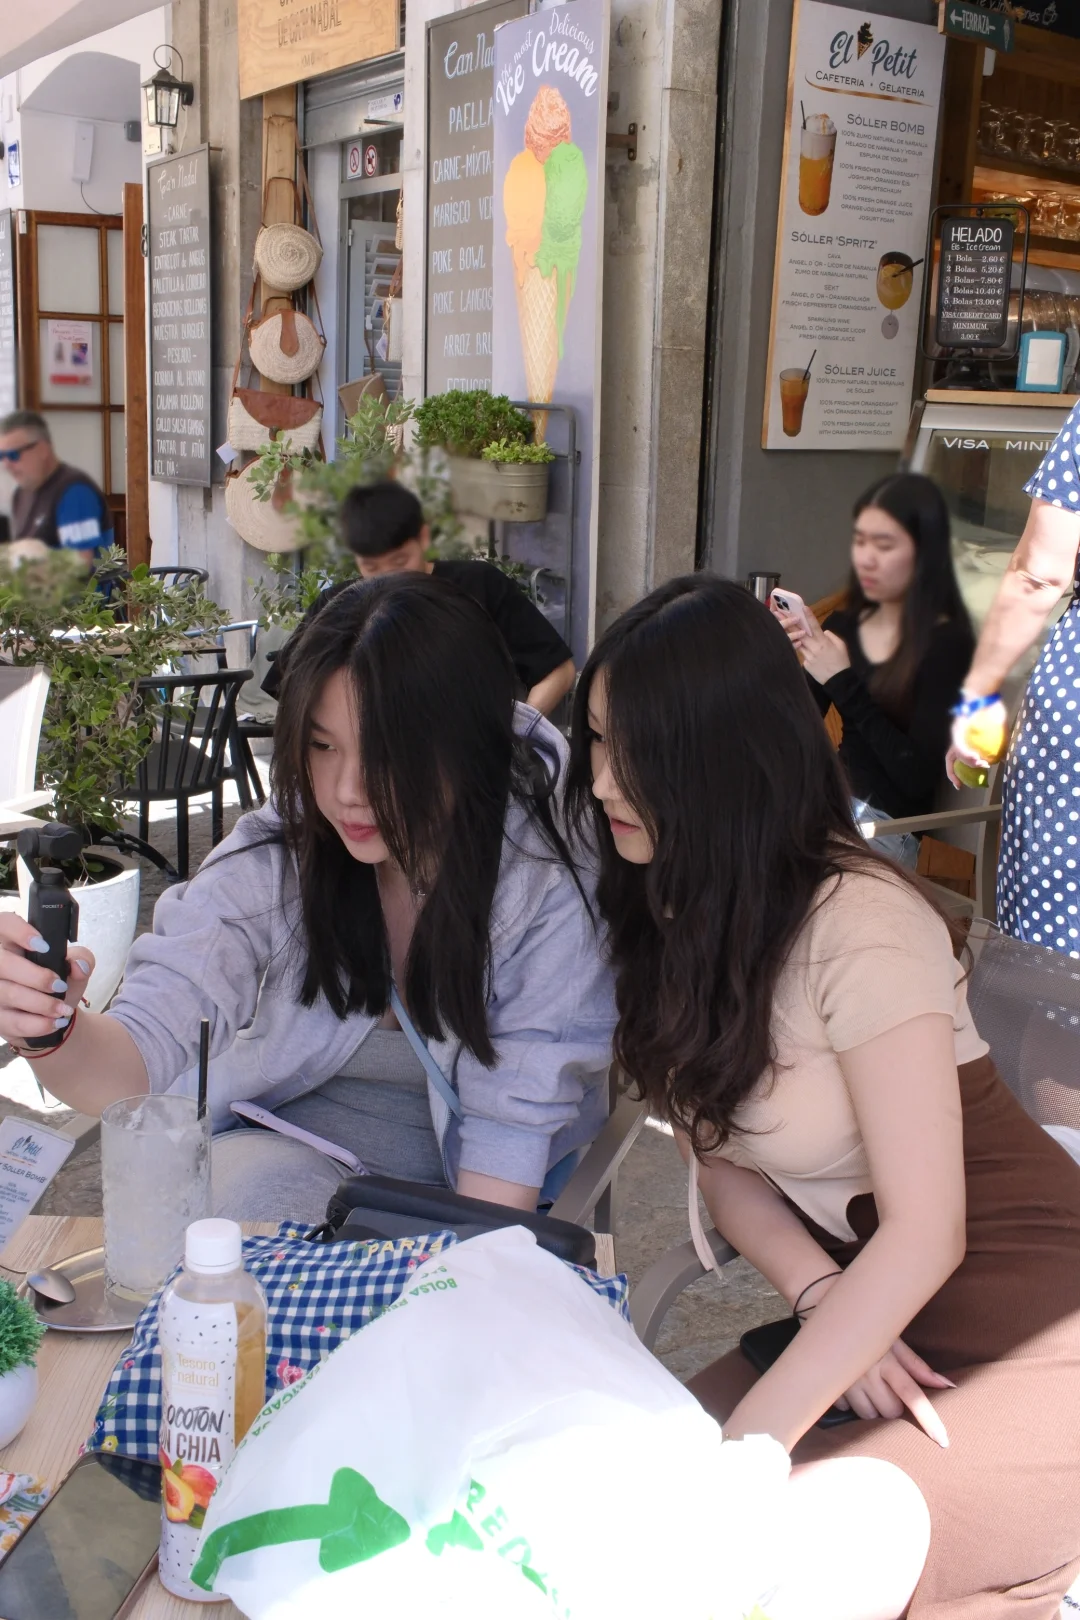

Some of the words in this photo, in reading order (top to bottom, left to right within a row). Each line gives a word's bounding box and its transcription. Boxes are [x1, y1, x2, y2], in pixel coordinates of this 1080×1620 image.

[962, 9, 990, 35] TERRAZA
[501, 63, 512, 86] the
[514, 29, 533, 63] most
[549, 8, 595, 54] Delicious
[829, 31, 854, 69] El
[871, 40, 918, 79] Petit
[444, 41, 473, 79] Can
[495, 64, 525, 117] Ice
[532, 31, 598, 97] Cream
[815, 70, 865, 88] CAFETERIA
[878, 81, 925, 99] GELATERIA
[449, 97, 494, 134] PAELLA
[856, 132, 873, 140] ZUMO
[890, 120, 925, 136] BOMB
[845, 140, 867, 149] HELADO
[859, 151, 881, 160] ESPUMA
[857, 196, 875, 204] FRESH
[875, 198, 897, 207] ORANGE
[159, 229, 177, 248] STEAK
[179, 226, 200, 245] TARTAR
[951, 226, 1003, 243] HELADO
[951, 243, 960, 251] Eis
[965, 243, 978, 251] Ice
[978, 243, 1001, 252] Cream
[433, 248, 452, 275] POKE
[460, 245, 486, 270] BOWL
[955, 254, 973, 262] Bola
[981, 255, 998, 263] 2.60
[981, 266, 998, 274] 5.20
[954, 276, 975, 284] Bolas
[953, 286, 974, 294] Bolas
[433, 291, 454, 316] POKE
[952, 297, 973, 305] Bolas
[443, 333, 471, 357] ARROZ
[867, 366, 897, 378] JUICE
[172, 418, 187, 434] SALSA
[157, 439, 177, 455] TARTAR
[943, 437, 990, 450] VISA
[1005, 440, 1049, 451] MINI
[367, 1238, 443, 1257] PARIS
[409, 1278, 458, 1297] BOLSA
[177, 1352, 217, 1372] Tesoro
[177, 1370, 220, 1388] natural
[176, 1432, 222, 1463] CHIA
